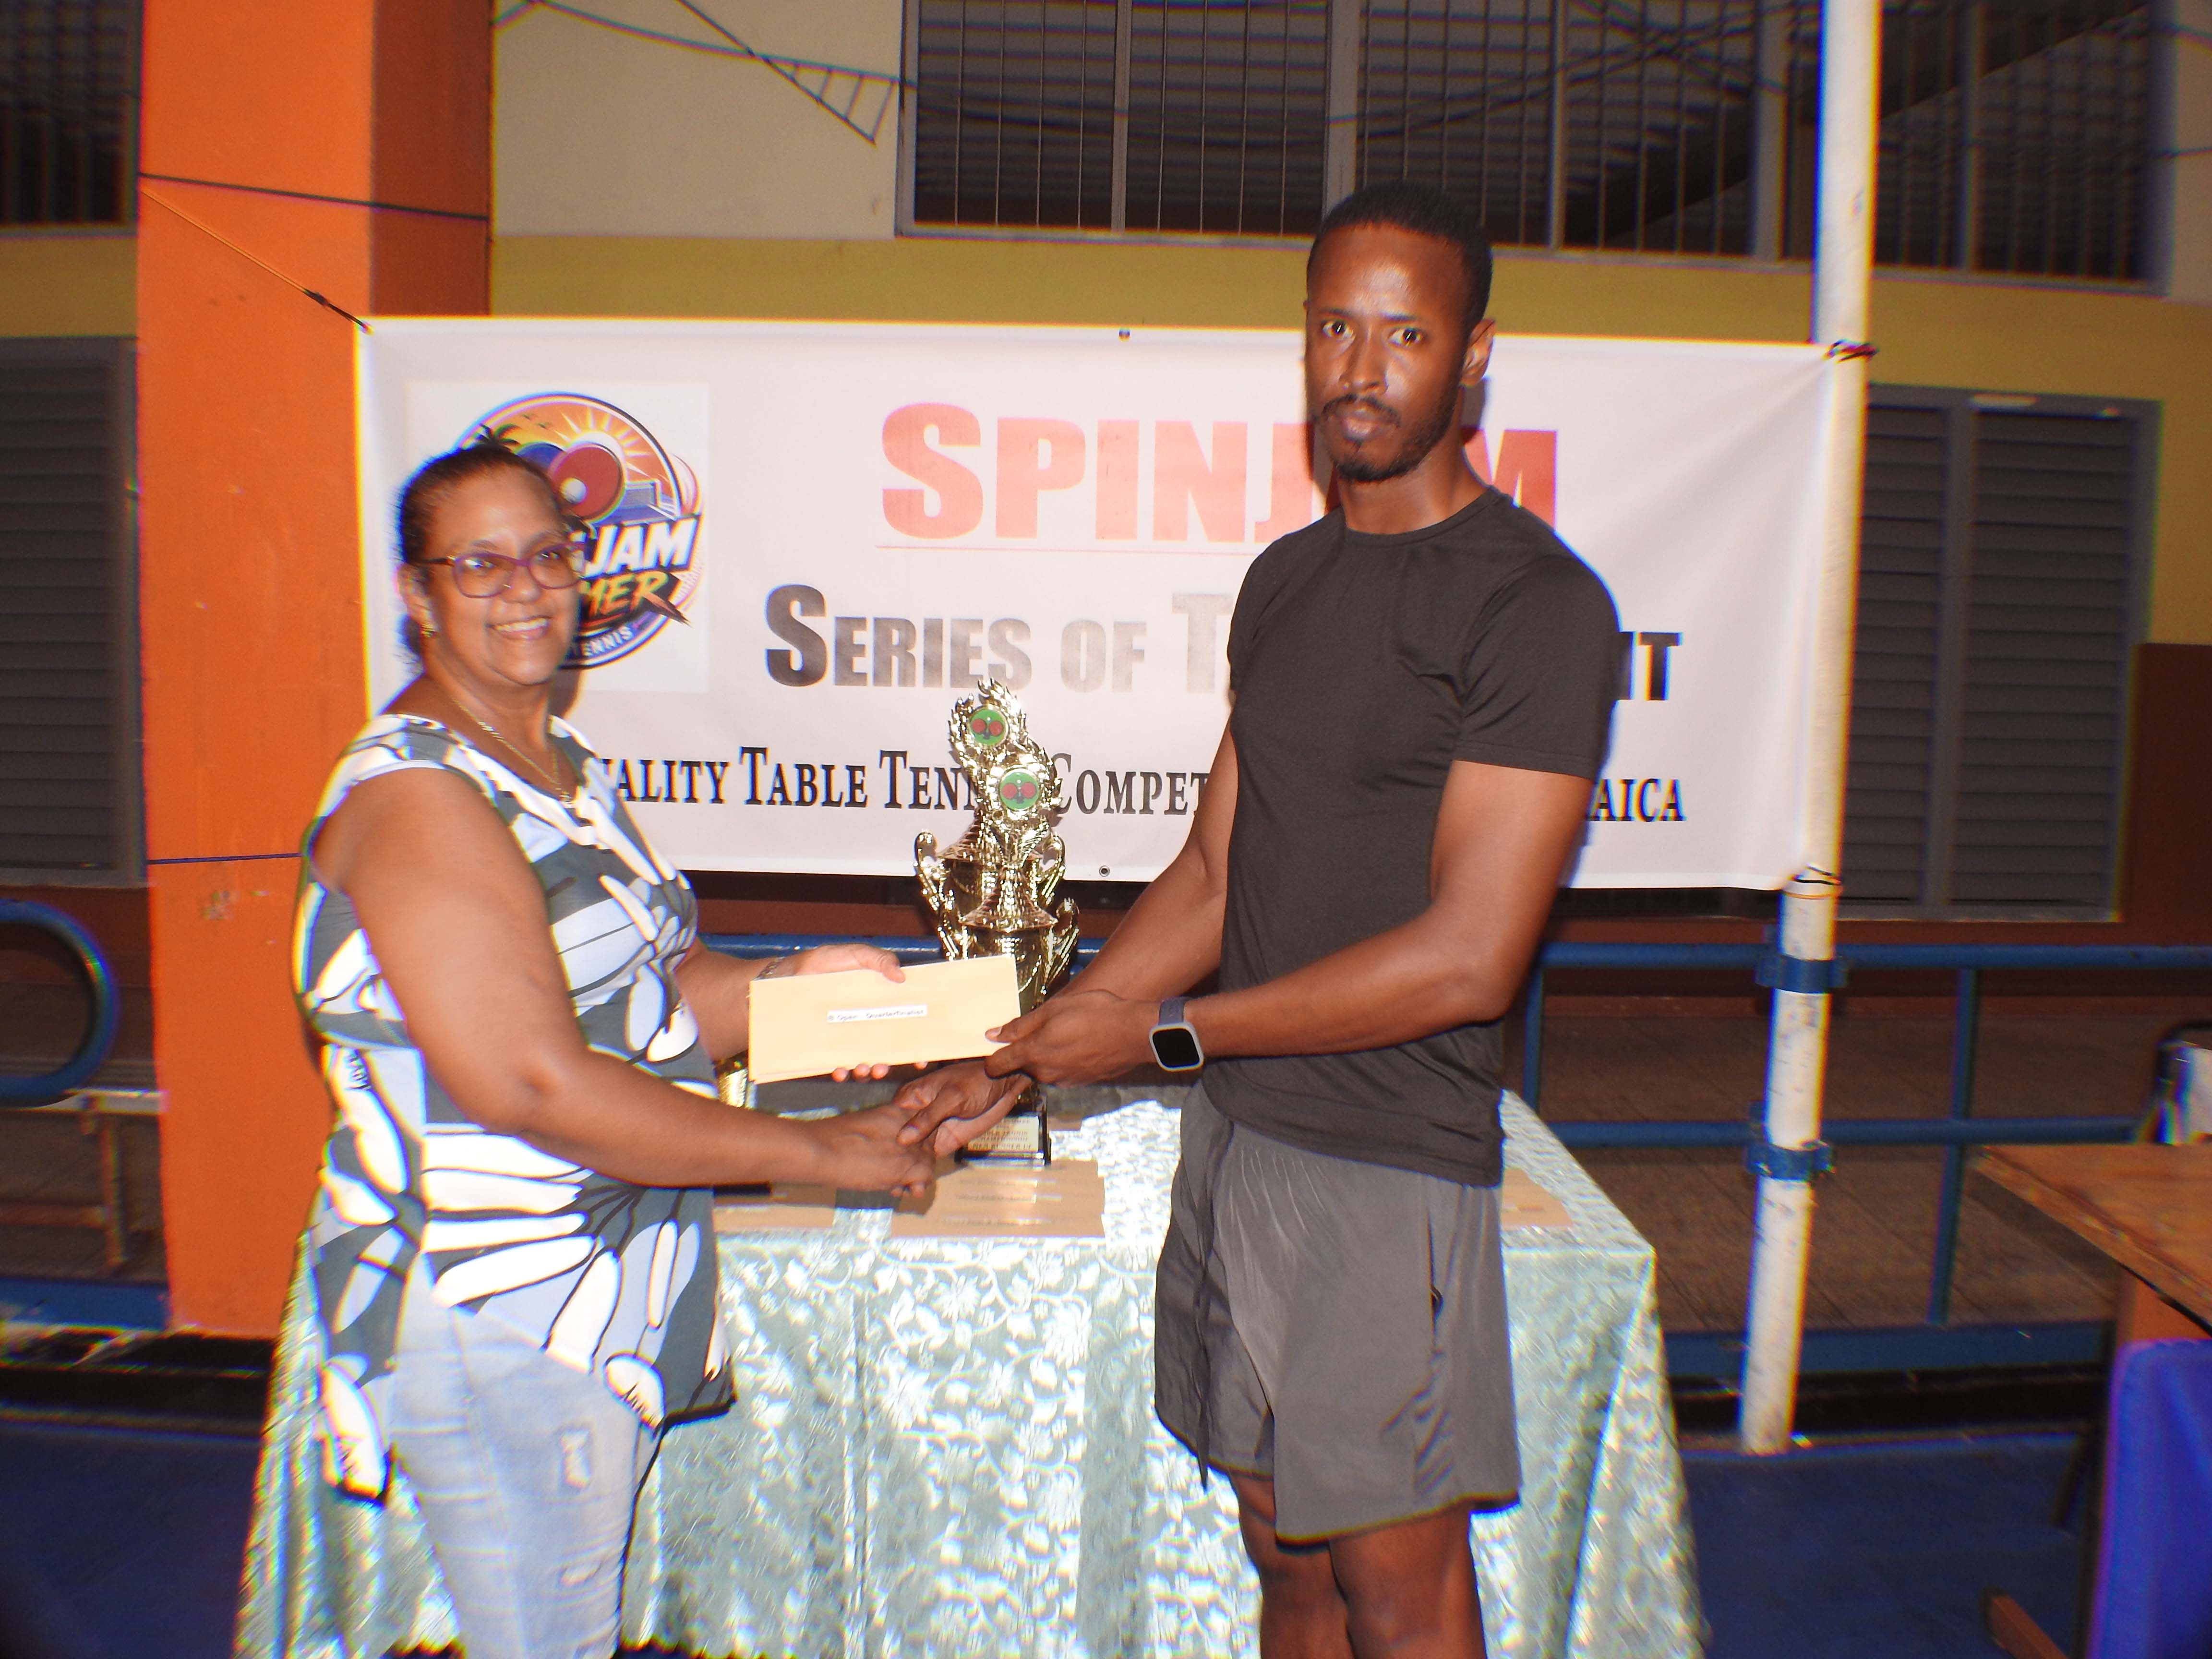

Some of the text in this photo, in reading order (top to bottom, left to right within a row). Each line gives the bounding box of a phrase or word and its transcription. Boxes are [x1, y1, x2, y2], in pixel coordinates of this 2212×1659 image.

[882, 402, 1557, 542] SPINJM
[580, 625, 634, 657] ENNIS
[764, 583, 1032, 688] SERIES
[1059, 619, 1147, 693] OF
[599, 758, 731, 804] ALITY
[738, 746, 869, 807] TABLE
[879, 749, 976, 810] TEN
[1586, 779, 1686, 822] AICA
